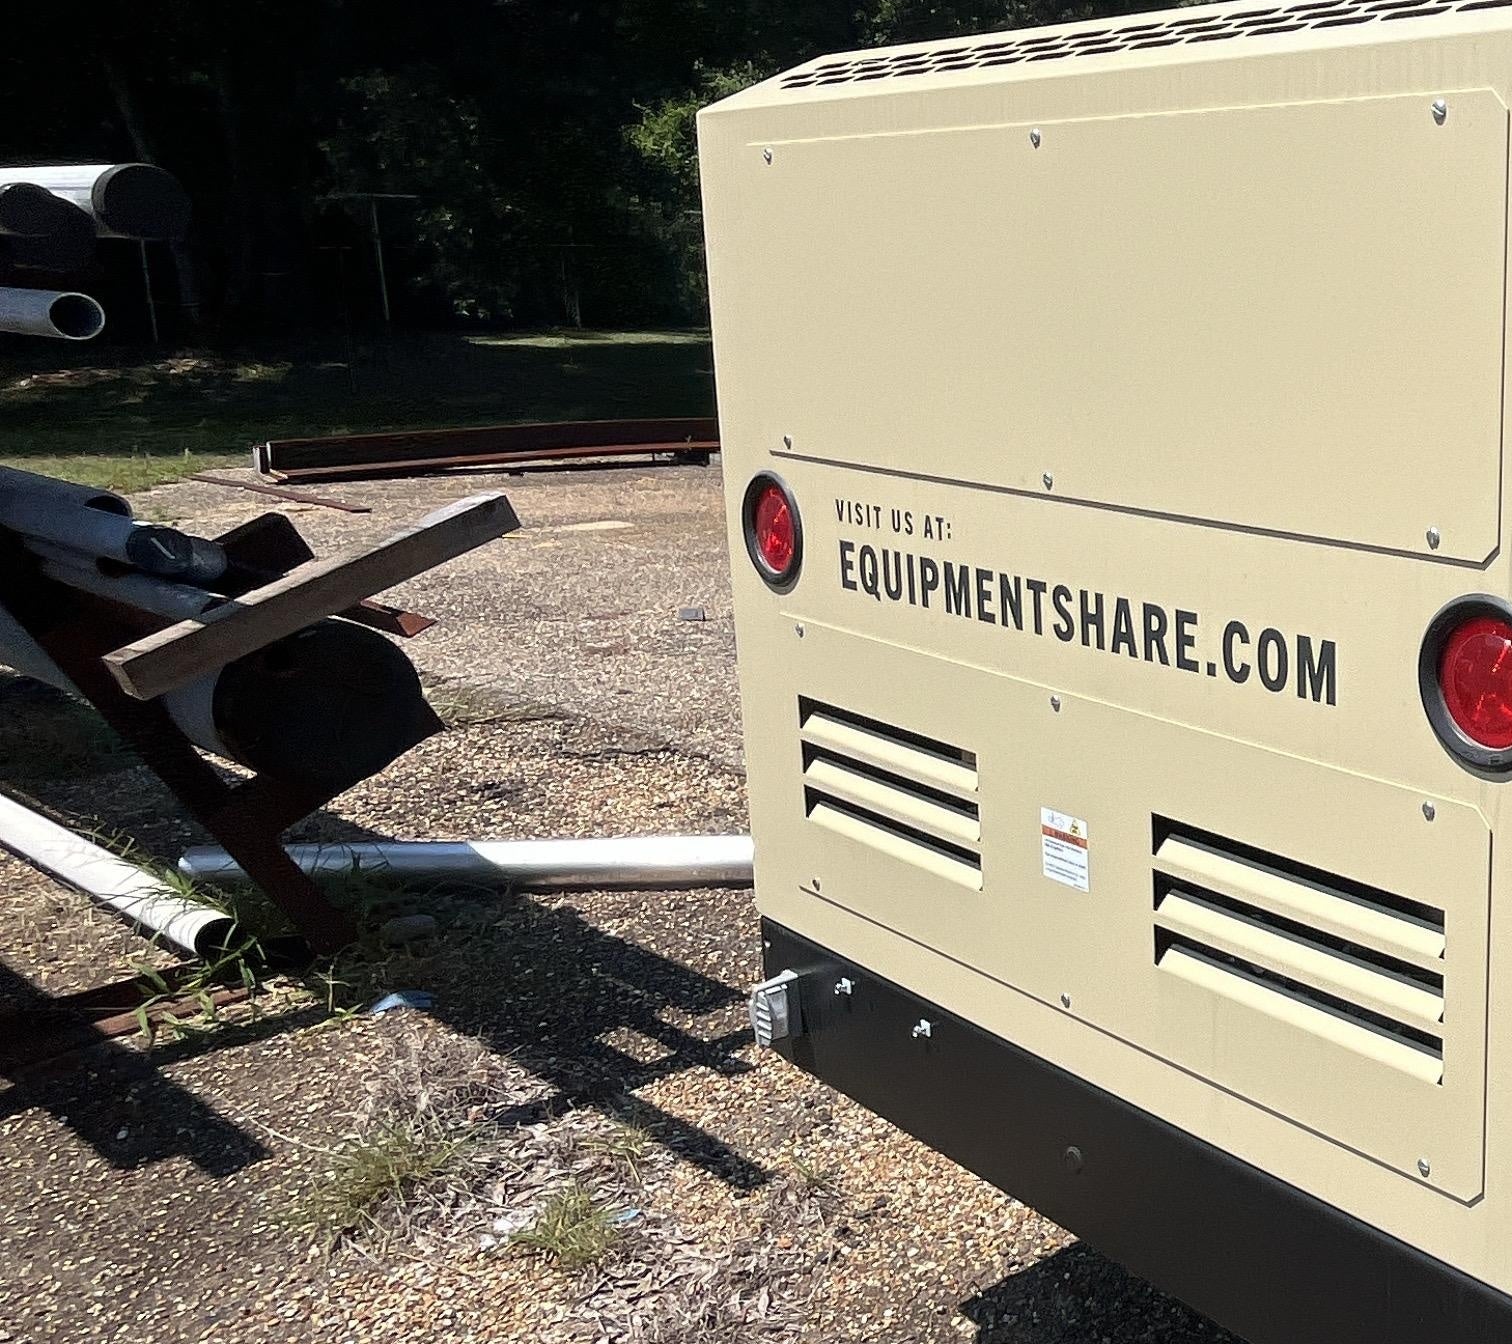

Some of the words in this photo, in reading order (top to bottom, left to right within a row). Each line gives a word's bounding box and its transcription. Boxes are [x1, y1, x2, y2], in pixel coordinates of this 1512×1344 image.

[835, 498, 882, 529] VISIT
[891, 508, 913, 535] US
[924, 514, 951, 541] AT:
[838, 539, 1337, 707] EQUIPMENTSHARE.COM
